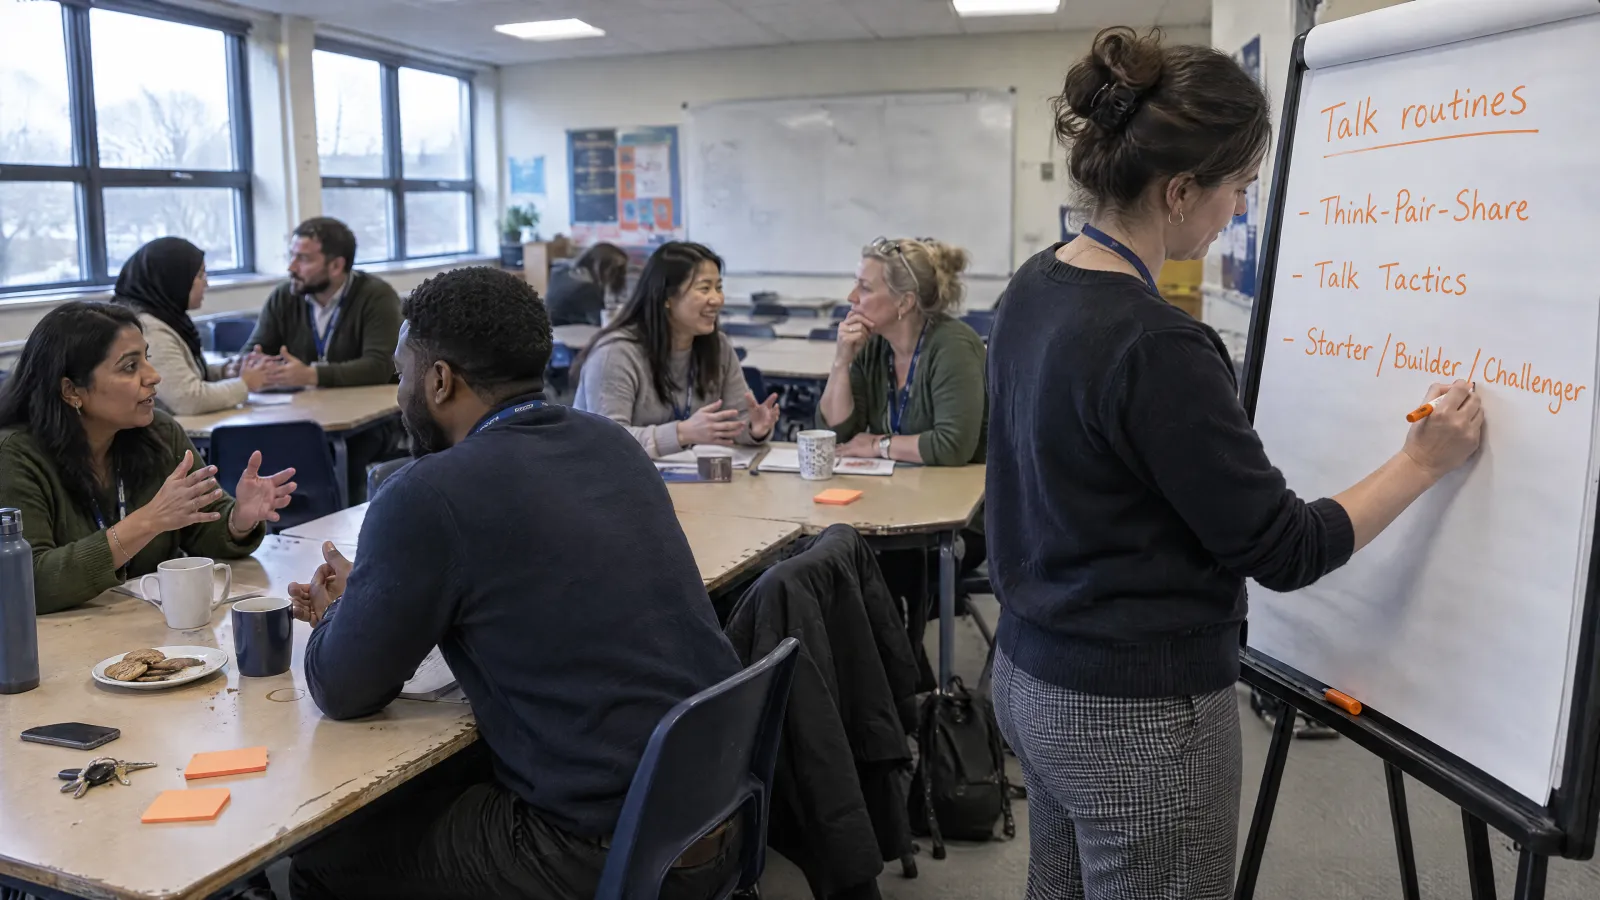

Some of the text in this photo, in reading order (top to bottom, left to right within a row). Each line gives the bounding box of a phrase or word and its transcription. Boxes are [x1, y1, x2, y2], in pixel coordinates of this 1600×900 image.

[1320, 85, 1527, 143] Talk routines
[1319, 188, 1529, 225] Think-Pair-Share
[1314, 260, 1360, 290] Talk
[1378, 262, 1468, 296] Tactics
